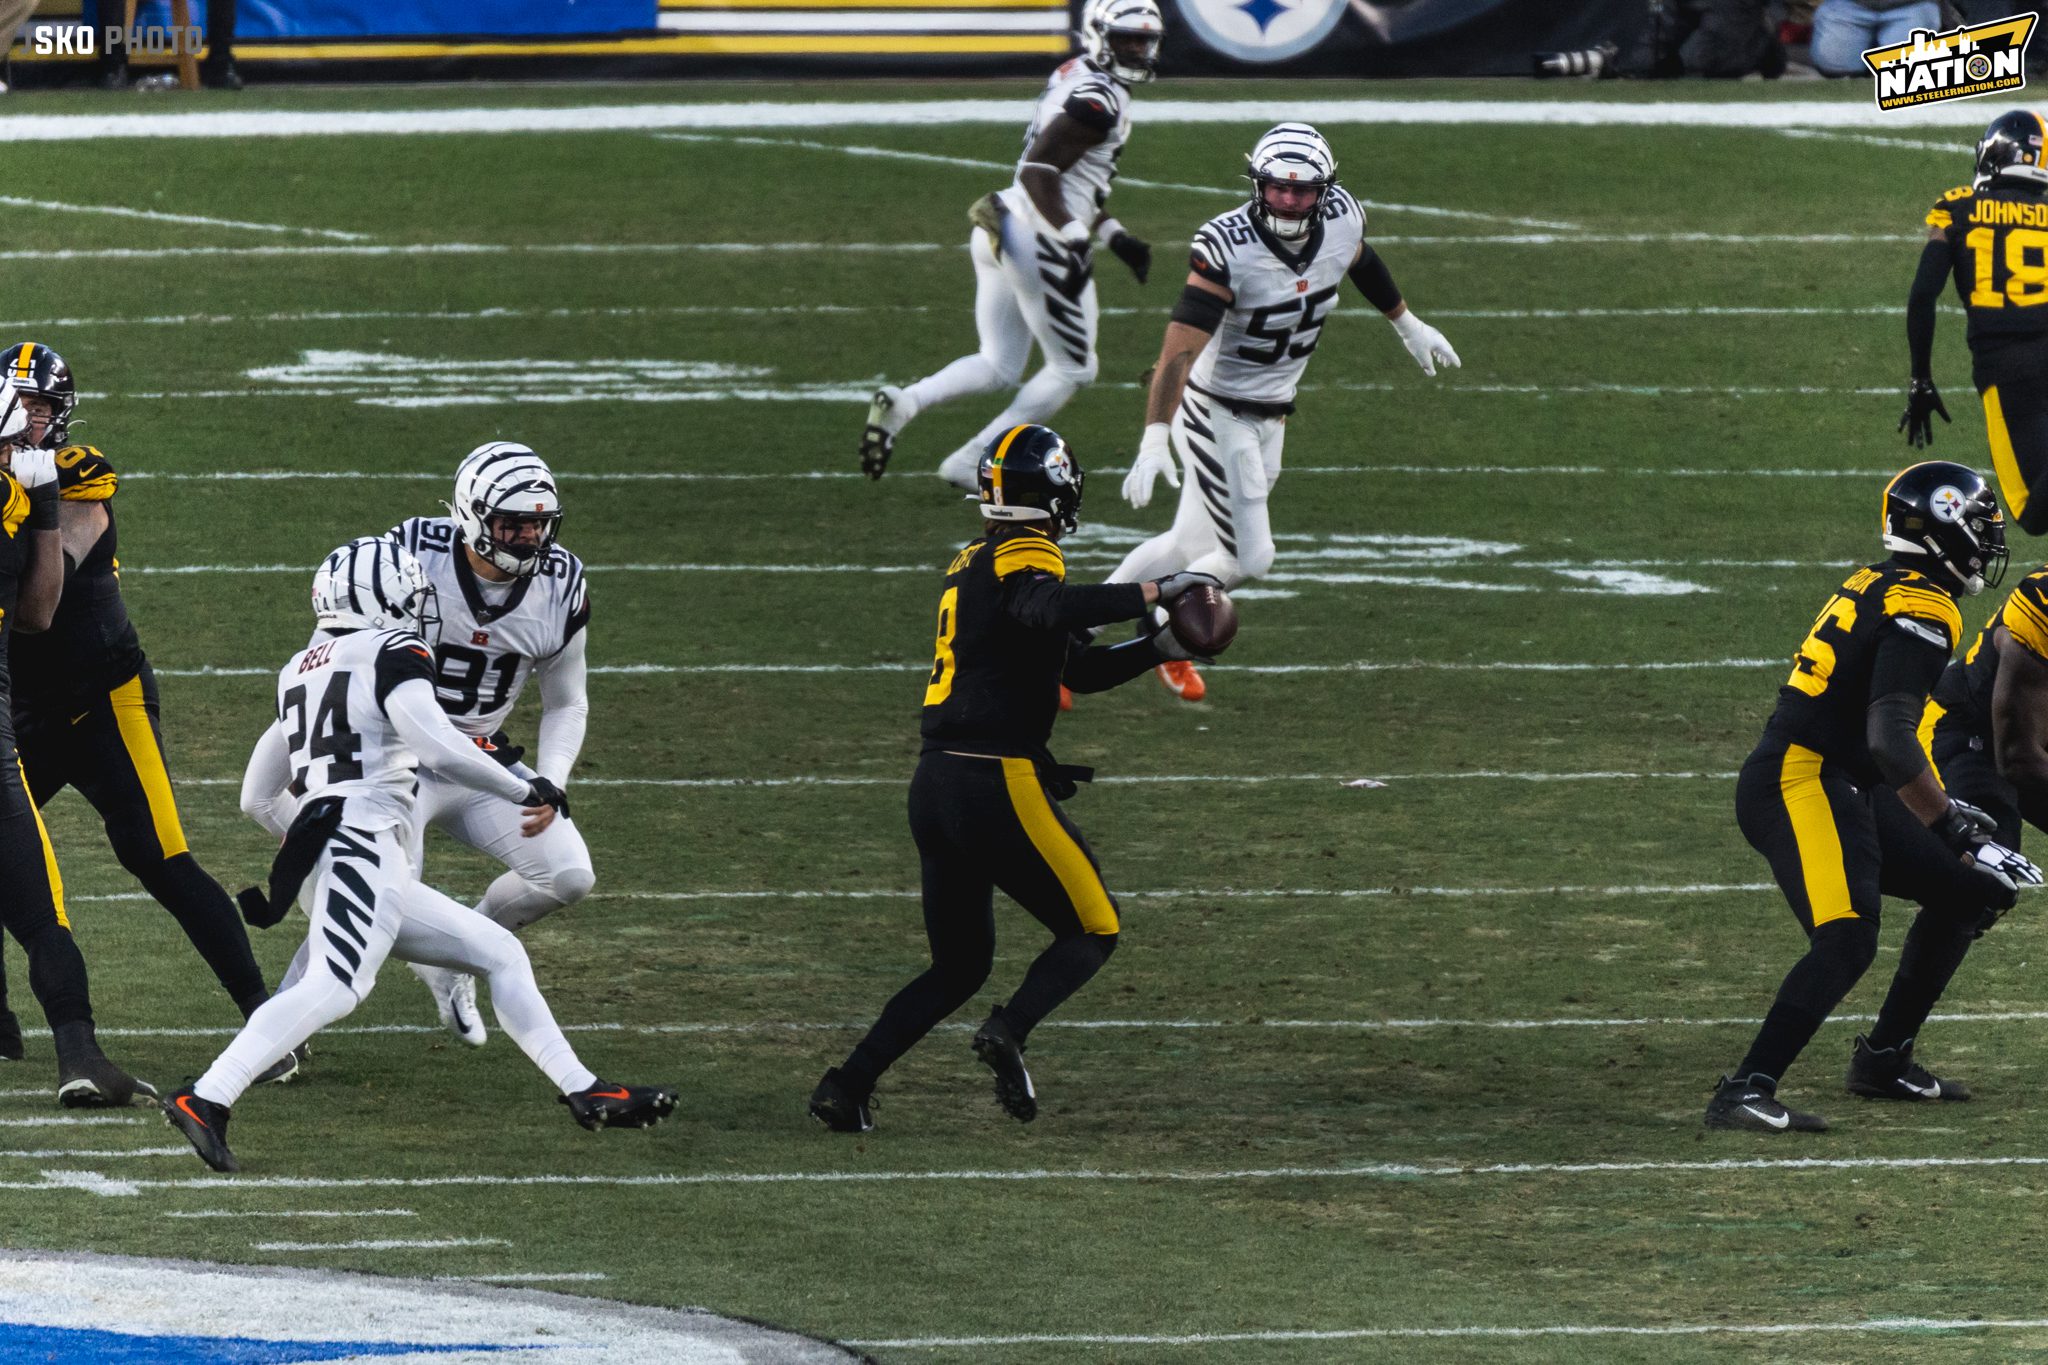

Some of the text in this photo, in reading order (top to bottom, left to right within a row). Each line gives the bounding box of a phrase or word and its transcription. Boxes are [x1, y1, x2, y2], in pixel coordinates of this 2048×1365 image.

[1218, 213, 1257, 245] 55
[1968, 199, 2048, 227] JOHNSO
[1966, 227, 2048, 308] 18
[1237, 284, 1339, 365] 55
[420, 520, 453, 554] 91
[299, 639, 336, 675] BELL
[435, 644, 520, 716] 91
[1787, 593, 1857, 697] 6
[282, 671, 362, 796] 24
